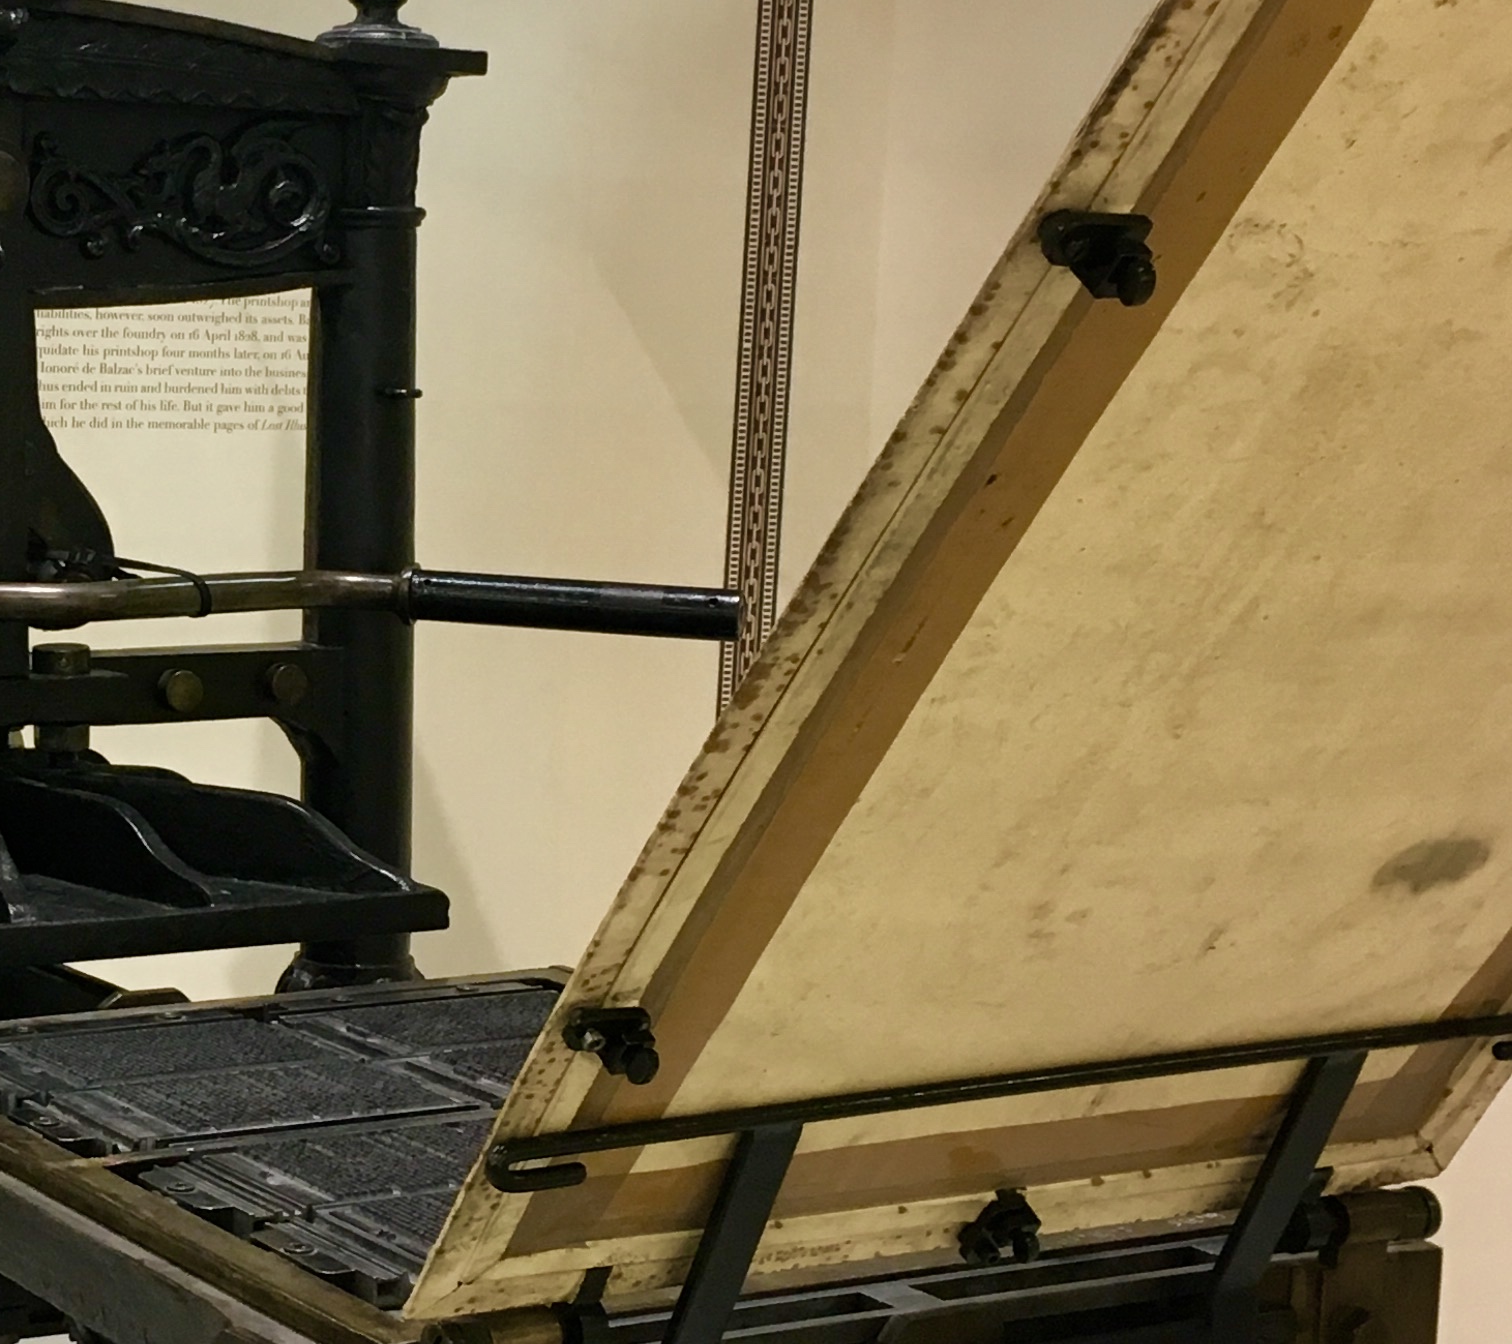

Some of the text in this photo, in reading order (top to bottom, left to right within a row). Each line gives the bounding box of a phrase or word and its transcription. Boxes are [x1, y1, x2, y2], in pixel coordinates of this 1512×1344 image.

[36, 325, 69, 340] rights
[71, 329, 98, 337] over
[100, 326, 119, 338] the
[122, 326, 165, 343] foundry
[169, 331, 184, 339] on
[188, 328, 199, 340] 16
[204, 328, 230, 344] April
[262, 330, 283, 342] and
[287, 334, 307, 343] was
[59, 397, 77, 410] for
[79, 398, 98, 410] the
[100, 400, 121, 410] rest
[125, 400, 140, 411] of
[140, 401, 156, 411] his
[182, 399, 202, 412] But
[205, 400, 213, 412] it
[215, 403, 240, 413] gave
[243, 400, 265, 412] him
[267, 404, 274, 412] a
[276, 401, 303, 414] good
